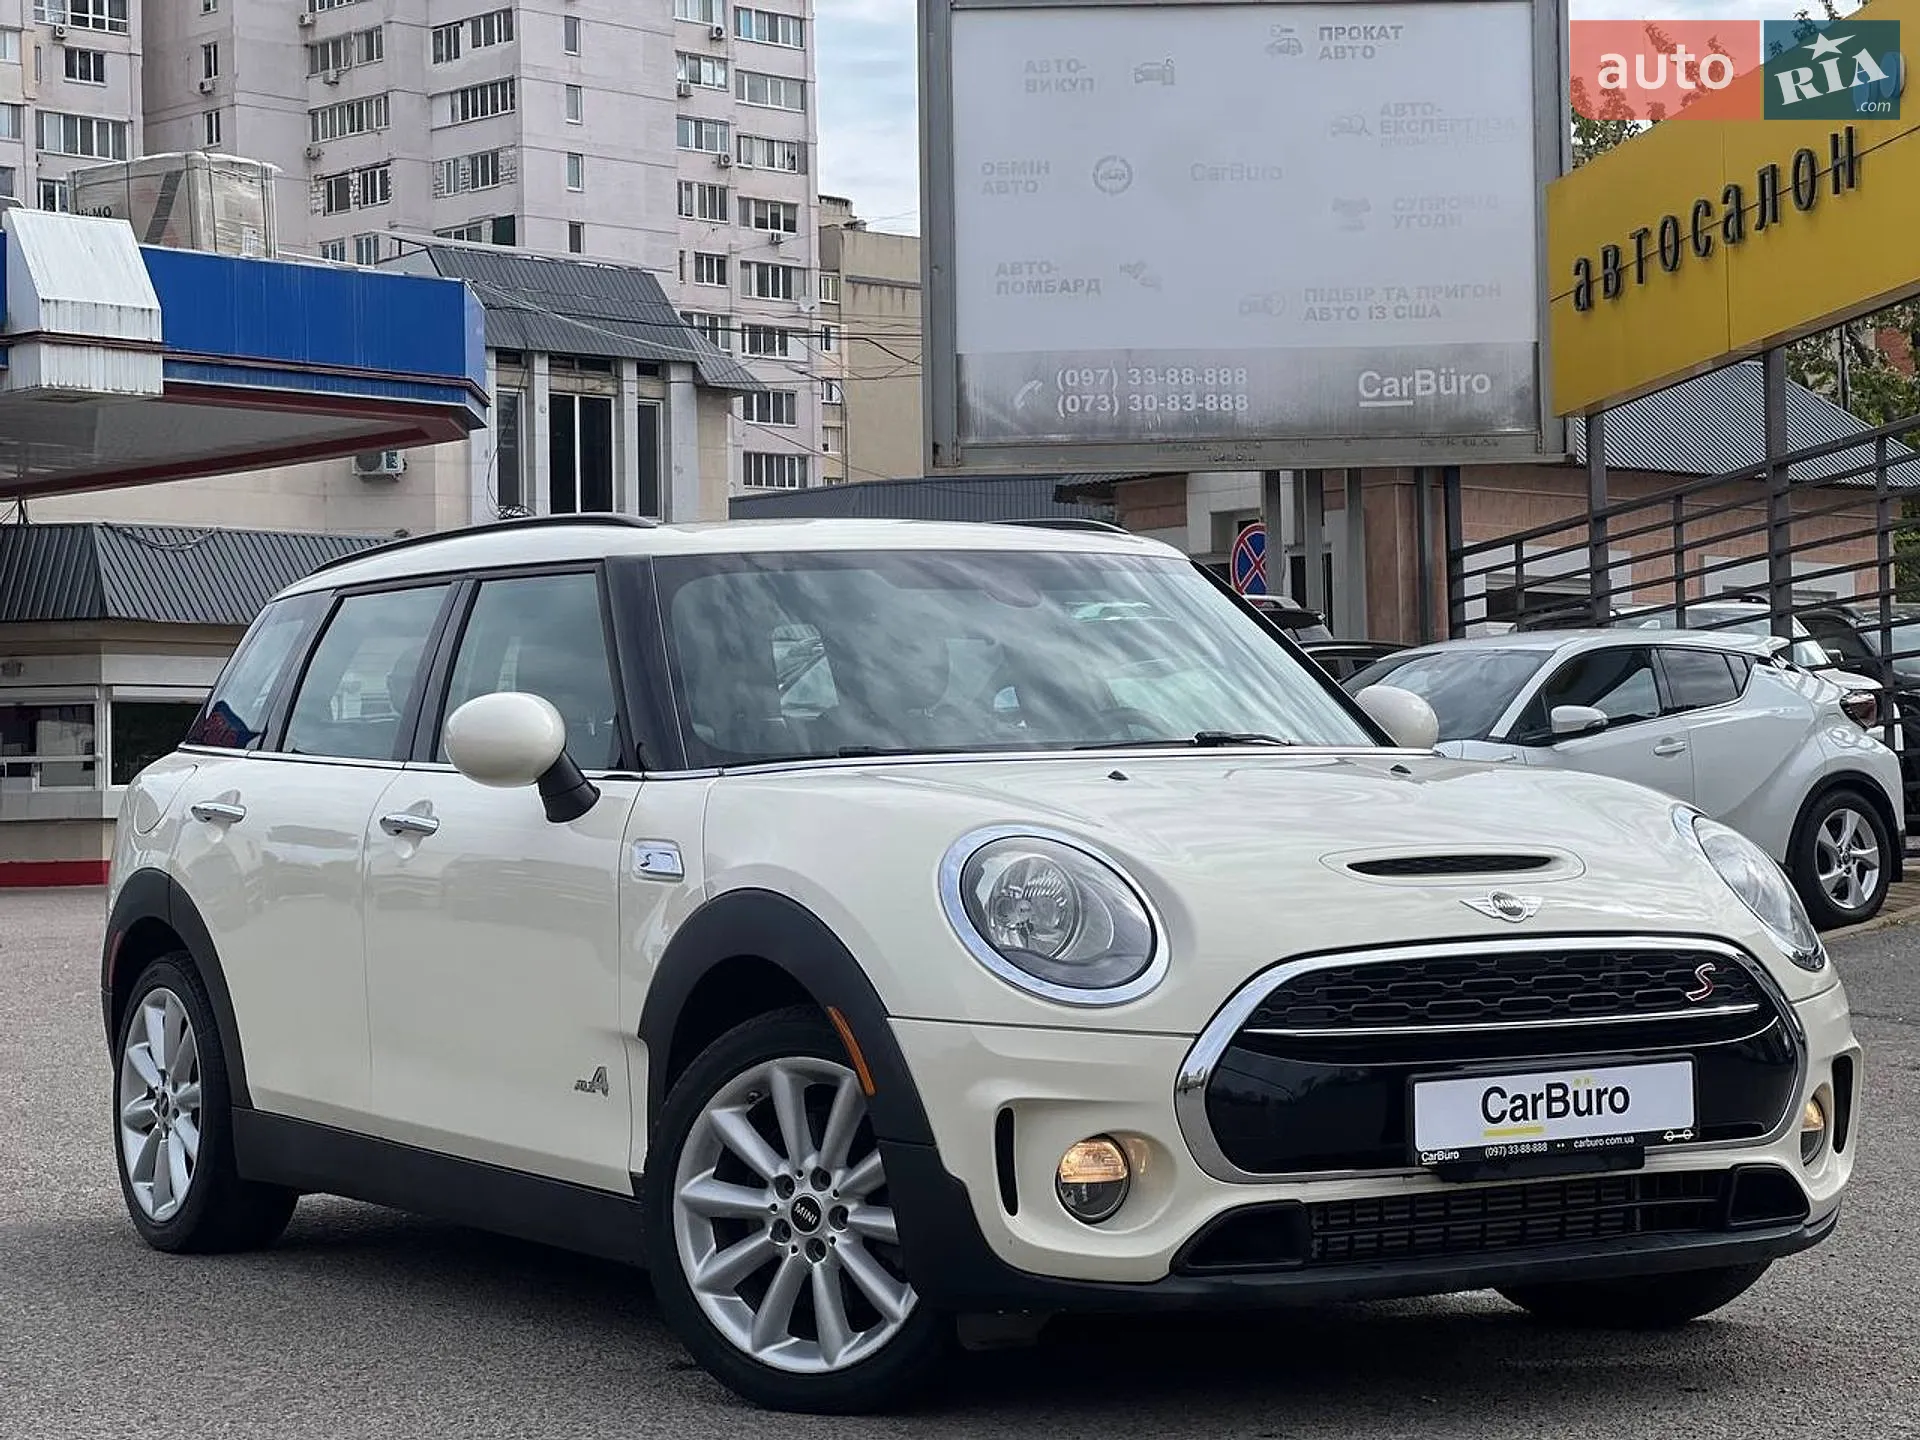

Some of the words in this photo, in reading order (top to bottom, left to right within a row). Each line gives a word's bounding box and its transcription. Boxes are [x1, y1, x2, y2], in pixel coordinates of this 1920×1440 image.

[1318, 25, 1404, 42] ПРОКАТ
[1318, 44, 1377, 61] АВТО
[1024, 58, 1087, 74] АВТО-
[1025, 77, 1095, 94] ВИКУП
[1379, 102, 1443, 117] АВТО-
[981, 160, 1050, 176] ОБМІН
[981, 180, 1039, 196] АВТО
[1391, 212, 1462, 230] УГОДИ
[1573, 125, 1857, 312] автосалон
[995, 261, 1060, 277] АВТО-
[1304, 287, 1376, 304] ПІДБІР
[1383, 286, 1410, 302] ТА
[1416, 284, 1502, 302] ПРИГОН
[1304, 305, 1360, 322] АВТО
[1368, 304, 1388, 320] ІЗ
[1393, 302, 1442, 320] США
[1057, 367, 1119, 392] (097)
[1127, 367, 1247, 385] 33-88-888
[1358, 367, 1492, 398] CarBüro
[1057, 394, 1119, 418] (073)
[1128, 393, 1249, 412] 30-83-888
[1685, 962, 1716, 1001] S
[1485, 1145, 1507, 1159] (097)
[794, 1202, 817, 1225] MINI
